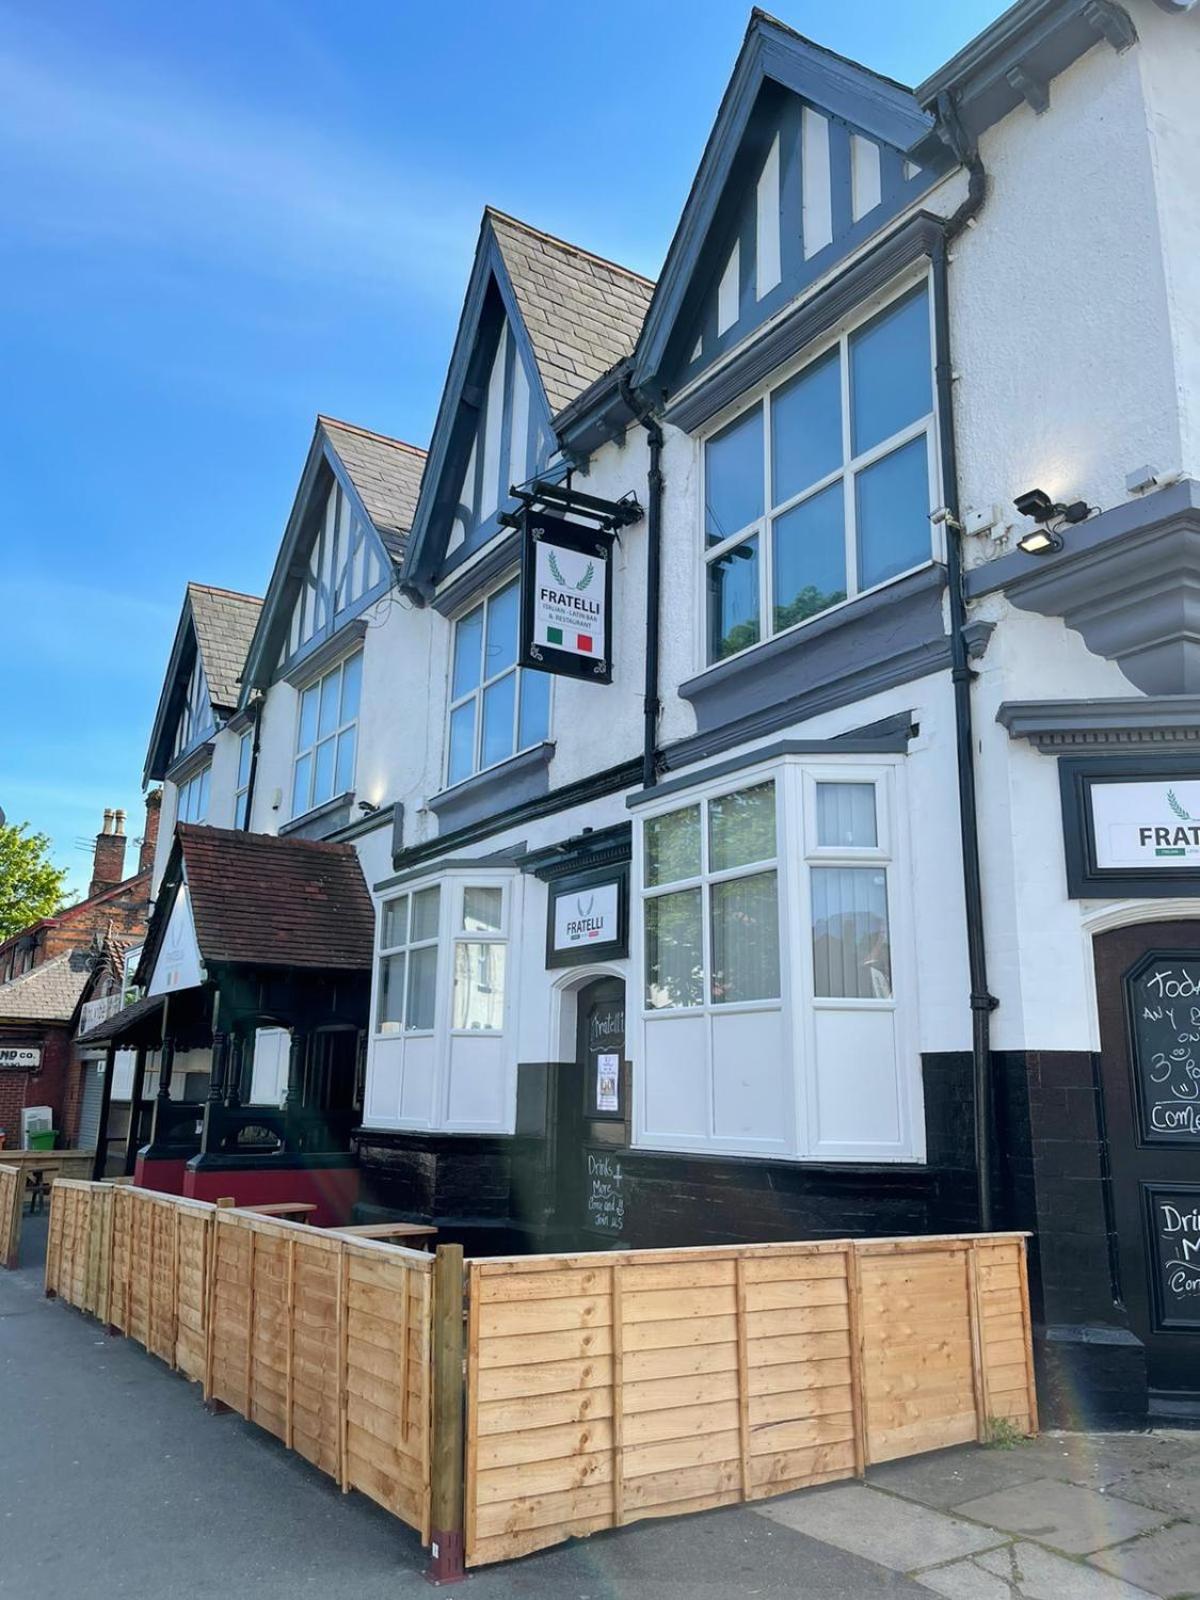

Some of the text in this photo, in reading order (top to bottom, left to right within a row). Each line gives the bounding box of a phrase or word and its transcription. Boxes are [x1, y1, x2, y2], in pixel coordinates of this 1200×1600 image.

[541, 588, 600, 615] FRATELLI
[1139, 826, 1200, 847] FRAT
[566, 916, 604, 936] FRATELLI
[1160, 1205, 1200, 1232] Dri
